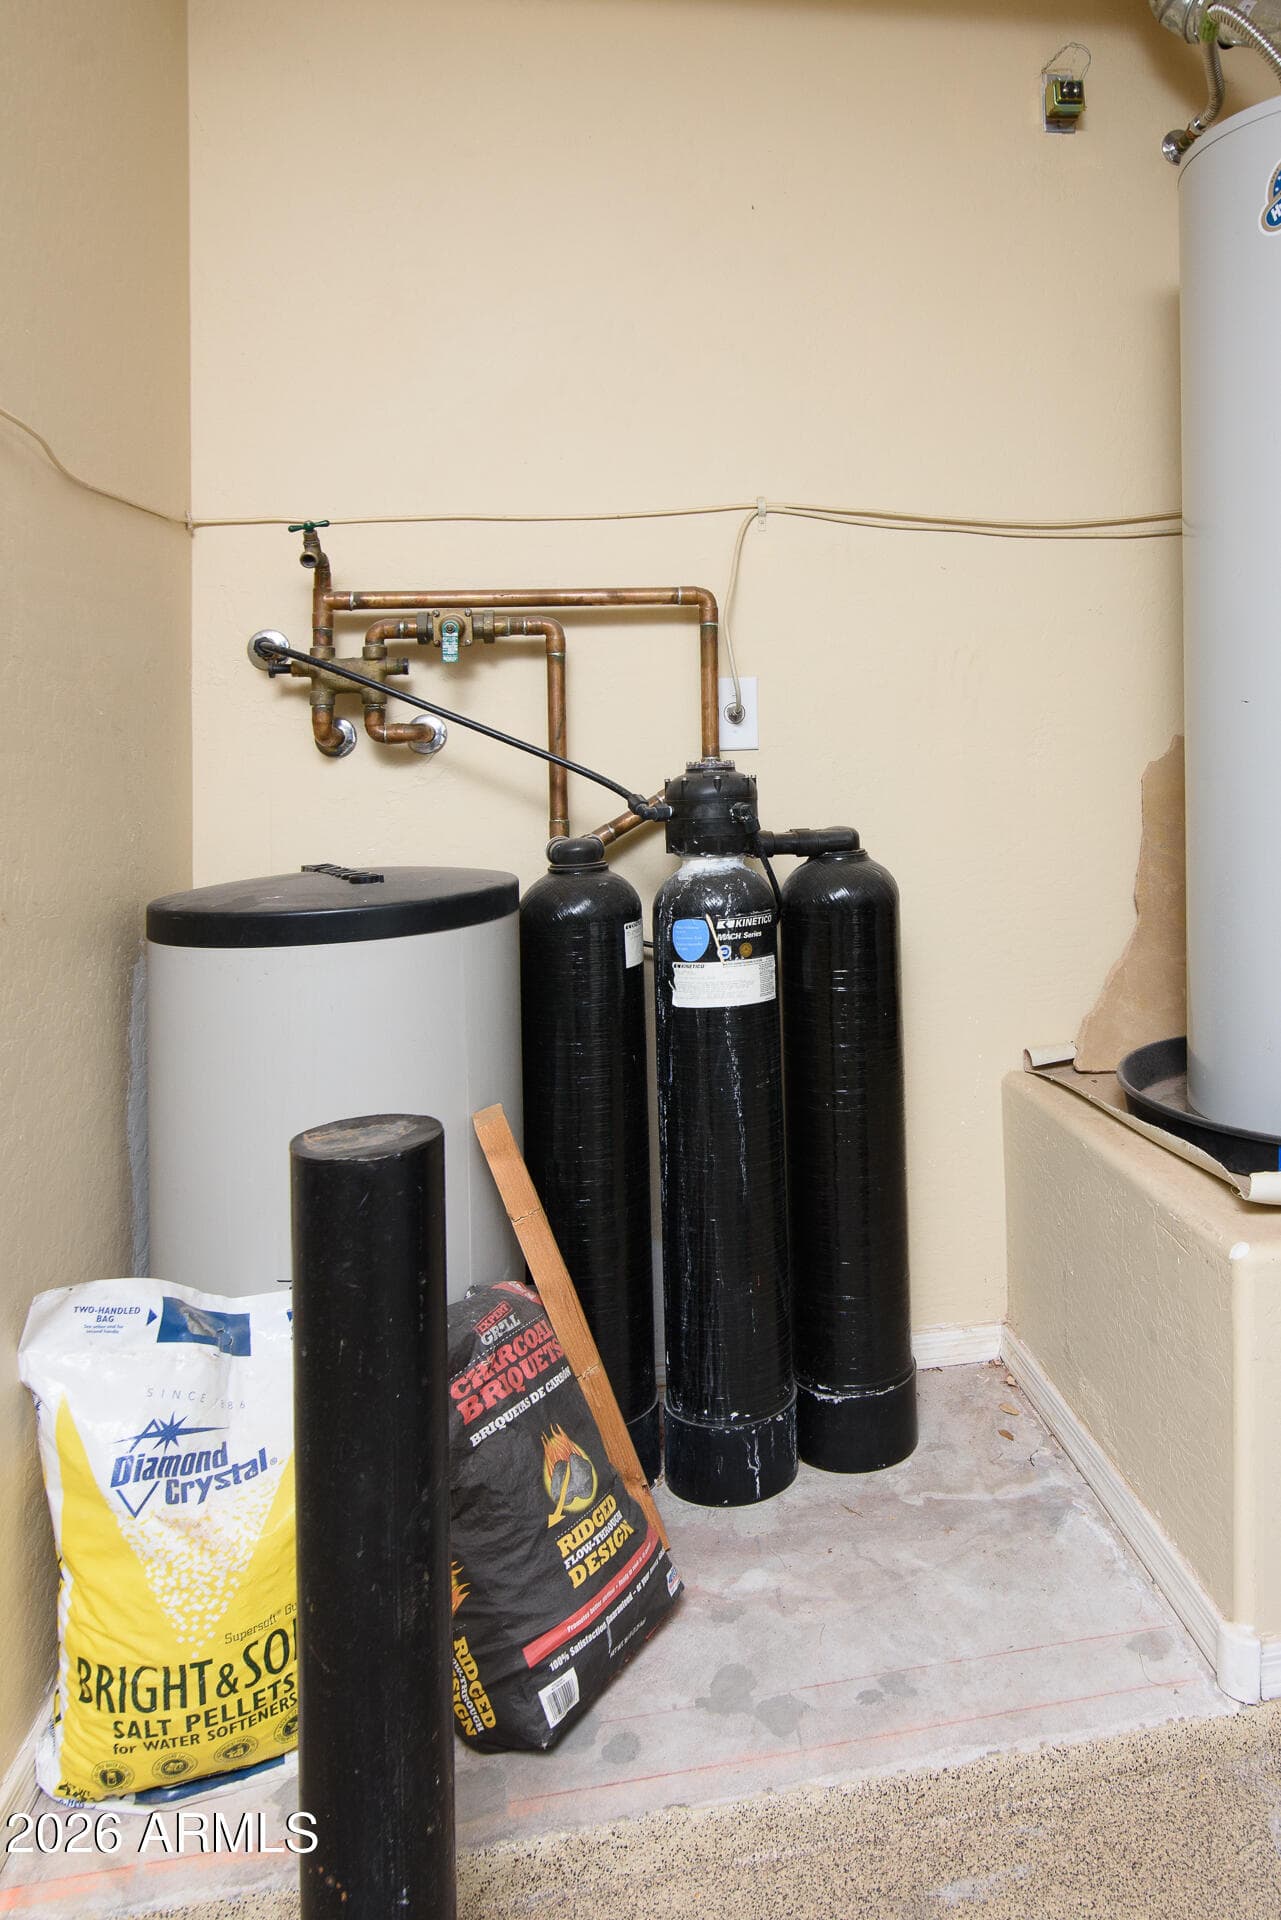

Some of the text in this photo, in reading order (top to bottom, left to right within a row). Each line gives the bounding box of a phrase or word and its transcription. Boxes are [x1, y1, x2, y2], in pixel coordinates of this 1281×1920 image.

[717, 930, 762, 941] MACH Series
[735, 914, 772, 928] KINETICO
[73, 1306, 141, 1315] TWO-HANDLED
[96, 1315, 115, 1323] BAG
[475, 1303, 511, 1333] EXPERT
[481, 1313, 521, 1346] GRILL
[450, 1318, 555, 1400] CHARCOAL
[456, 1338, 565, 1426] BRIQUETS
[146, 1388, 207, 1403] SINCE
[470, 1397, 532, 1447] BRIQUETAS
[531, 1386, 545, 1405] DE
[110, 1441, 229, 1488] Diamond
[165, 1447, 268, 1505] Crystal
[556, 1494, 617, 1558] RIDGED
[564, 1510, 623, 1570] FLOW-THROUGH
[568, 1519, 634, 1589] DESIGN
[77, 1618, 297, 1713] BRIGHT & SO
[549, 1652, 570, 1672] 100%
[569, 1620, 607, 1657] Satisfaction
[112, 1718, 171, 1739] SALT
[186, 1672, 295, 1734] PELLETS
[452, 1658, 485, 1733] OW-THROUGH
[452, 1669, 478, 1736] SIGN
[454, 1636, 496, 1728] RIDGED
[113, 1742, 136, 1756] for
[143, 1733, 200, 1752] WATER
[207, 1691, 297, 1741] SOFTENERS
